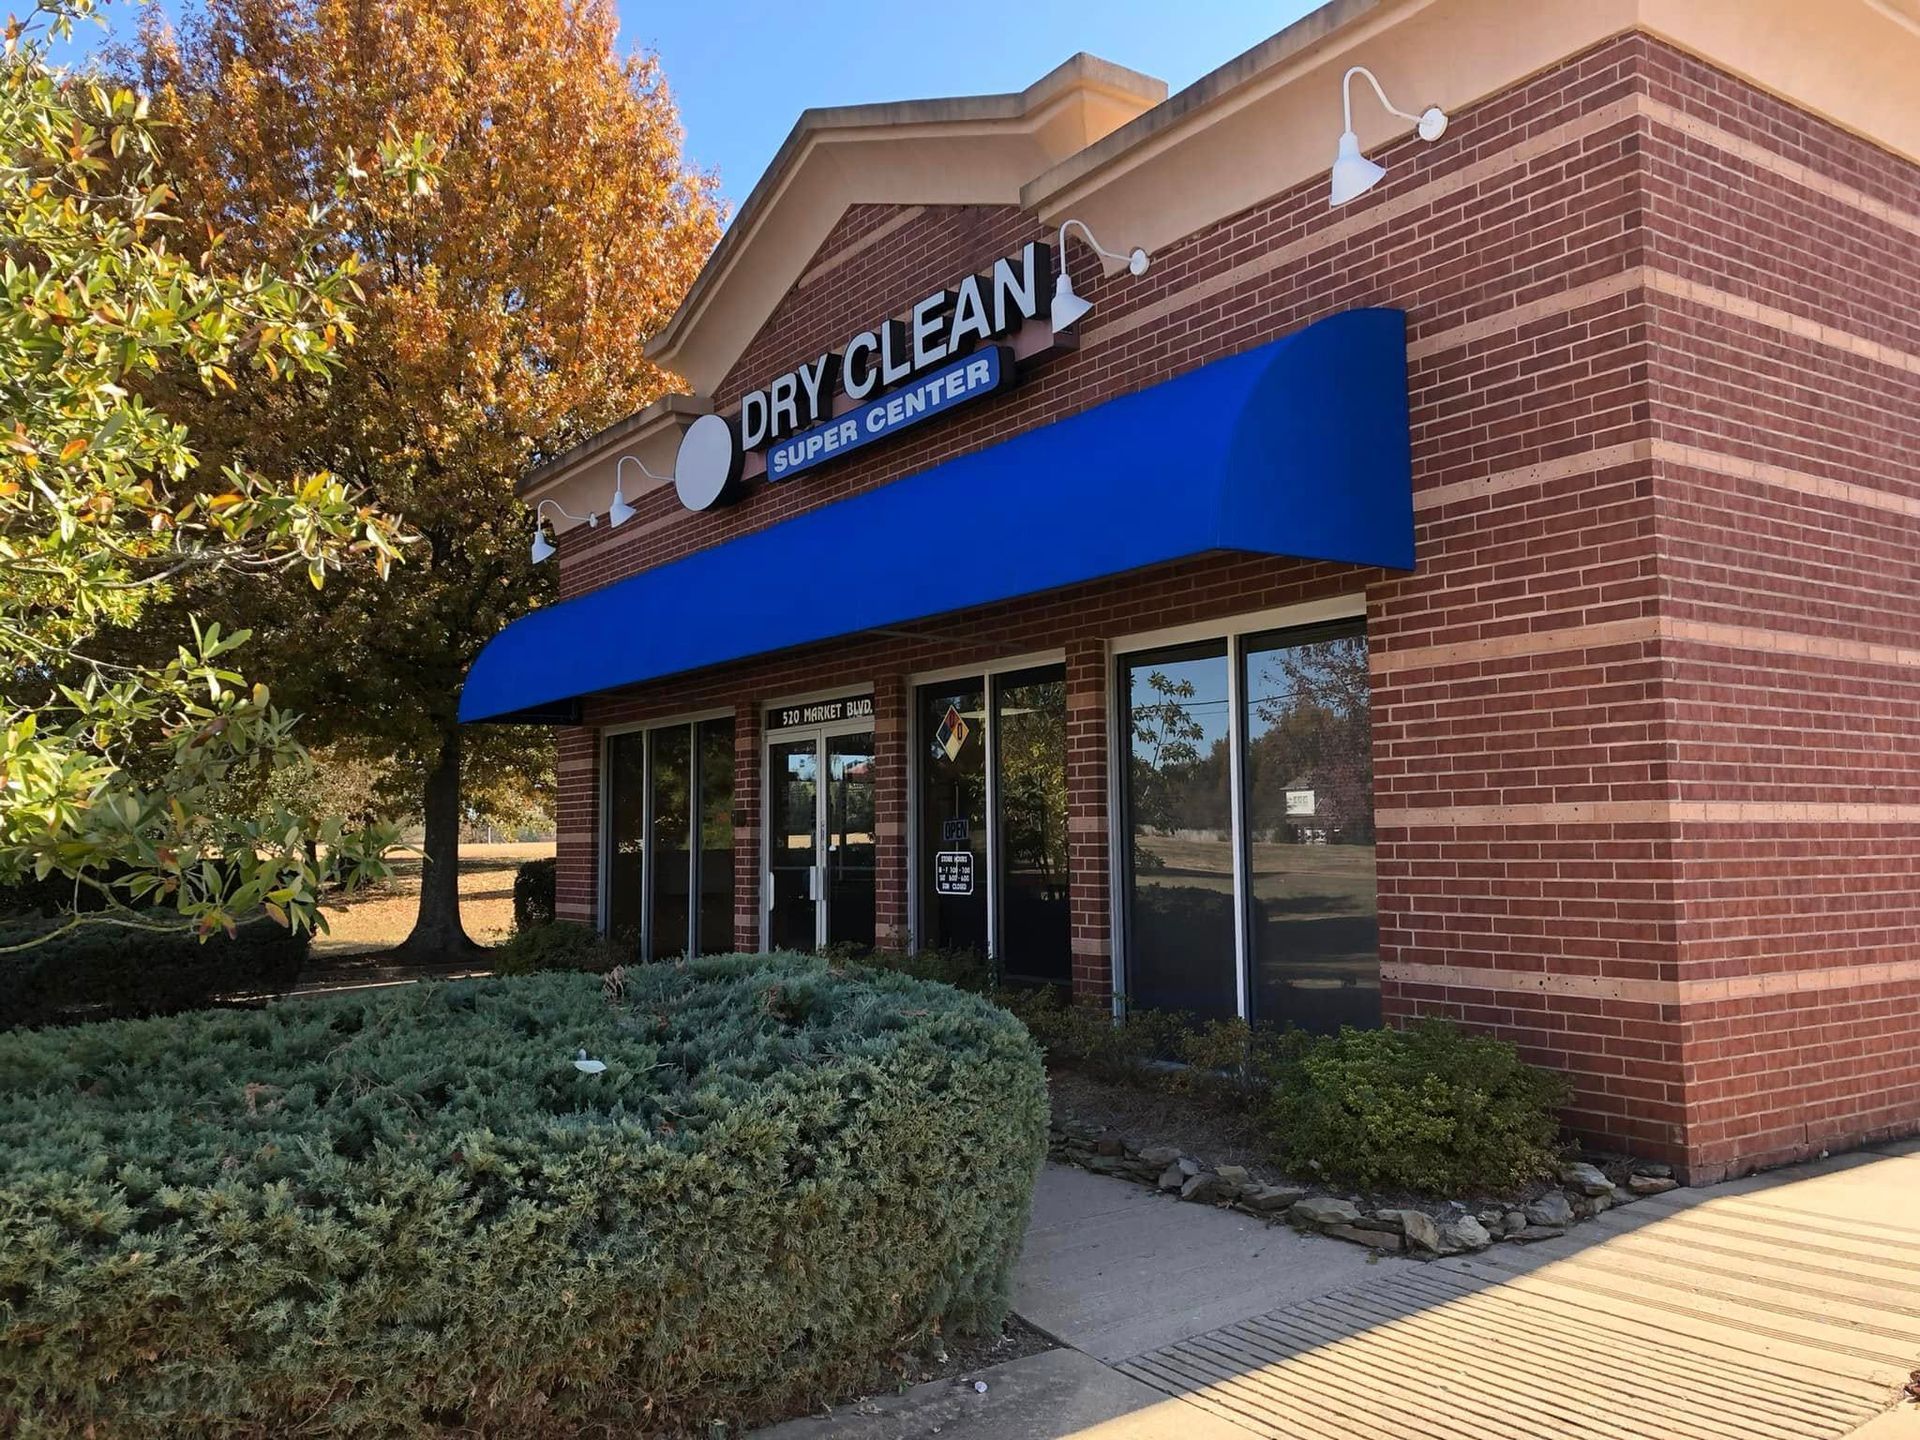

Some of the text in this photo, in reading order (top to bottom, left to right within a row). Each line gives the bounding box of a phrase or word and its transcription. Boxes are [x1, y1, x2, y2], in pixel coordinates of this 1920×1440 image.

[742, 242, 1036, 451] DRY CLEAN
[773, 359, 990, 474] SUPER CENTER
[783, 700, 873, 725] 520 MARKET BLVD.
[945, 821, 966, 839] OPEN
